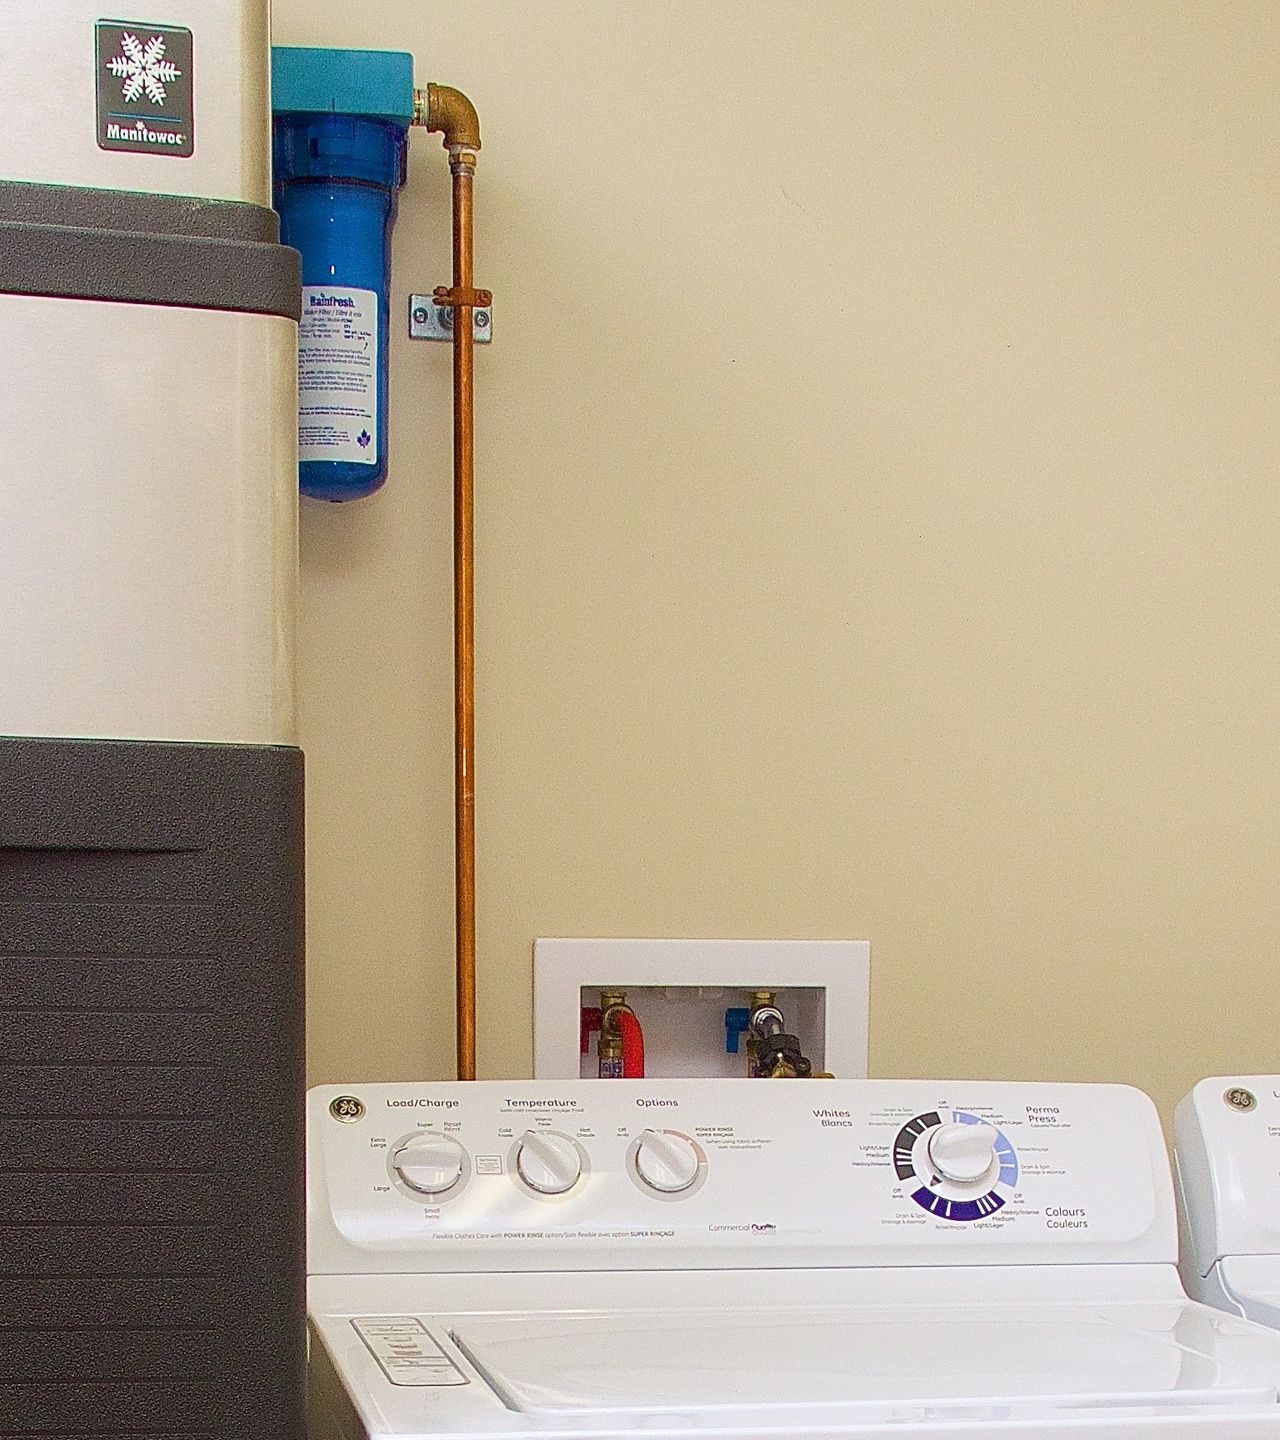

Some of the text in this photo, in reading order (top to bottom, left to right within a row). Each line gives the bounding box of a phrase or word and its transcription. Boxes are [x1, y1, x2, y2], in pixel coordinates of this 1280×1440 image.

[107, 122, 183, 145] Manitowoc
[387, 1099, 460, 1109] Load/Charge
[505, 1099, 577, 1108] Temperature
[636, 1098, 679, 1108] Options
[812, 1109, 851, 1118] Whites
[1025, 1106, 1060, 1114] Perma
[821, 1119, 853, 1127] Blancs
[1028, 1115, 1057, 1123] Press
[1045, 1206, 1086, 1217] Colours
[1046, 1219, 1088, 1229] Couleurs
